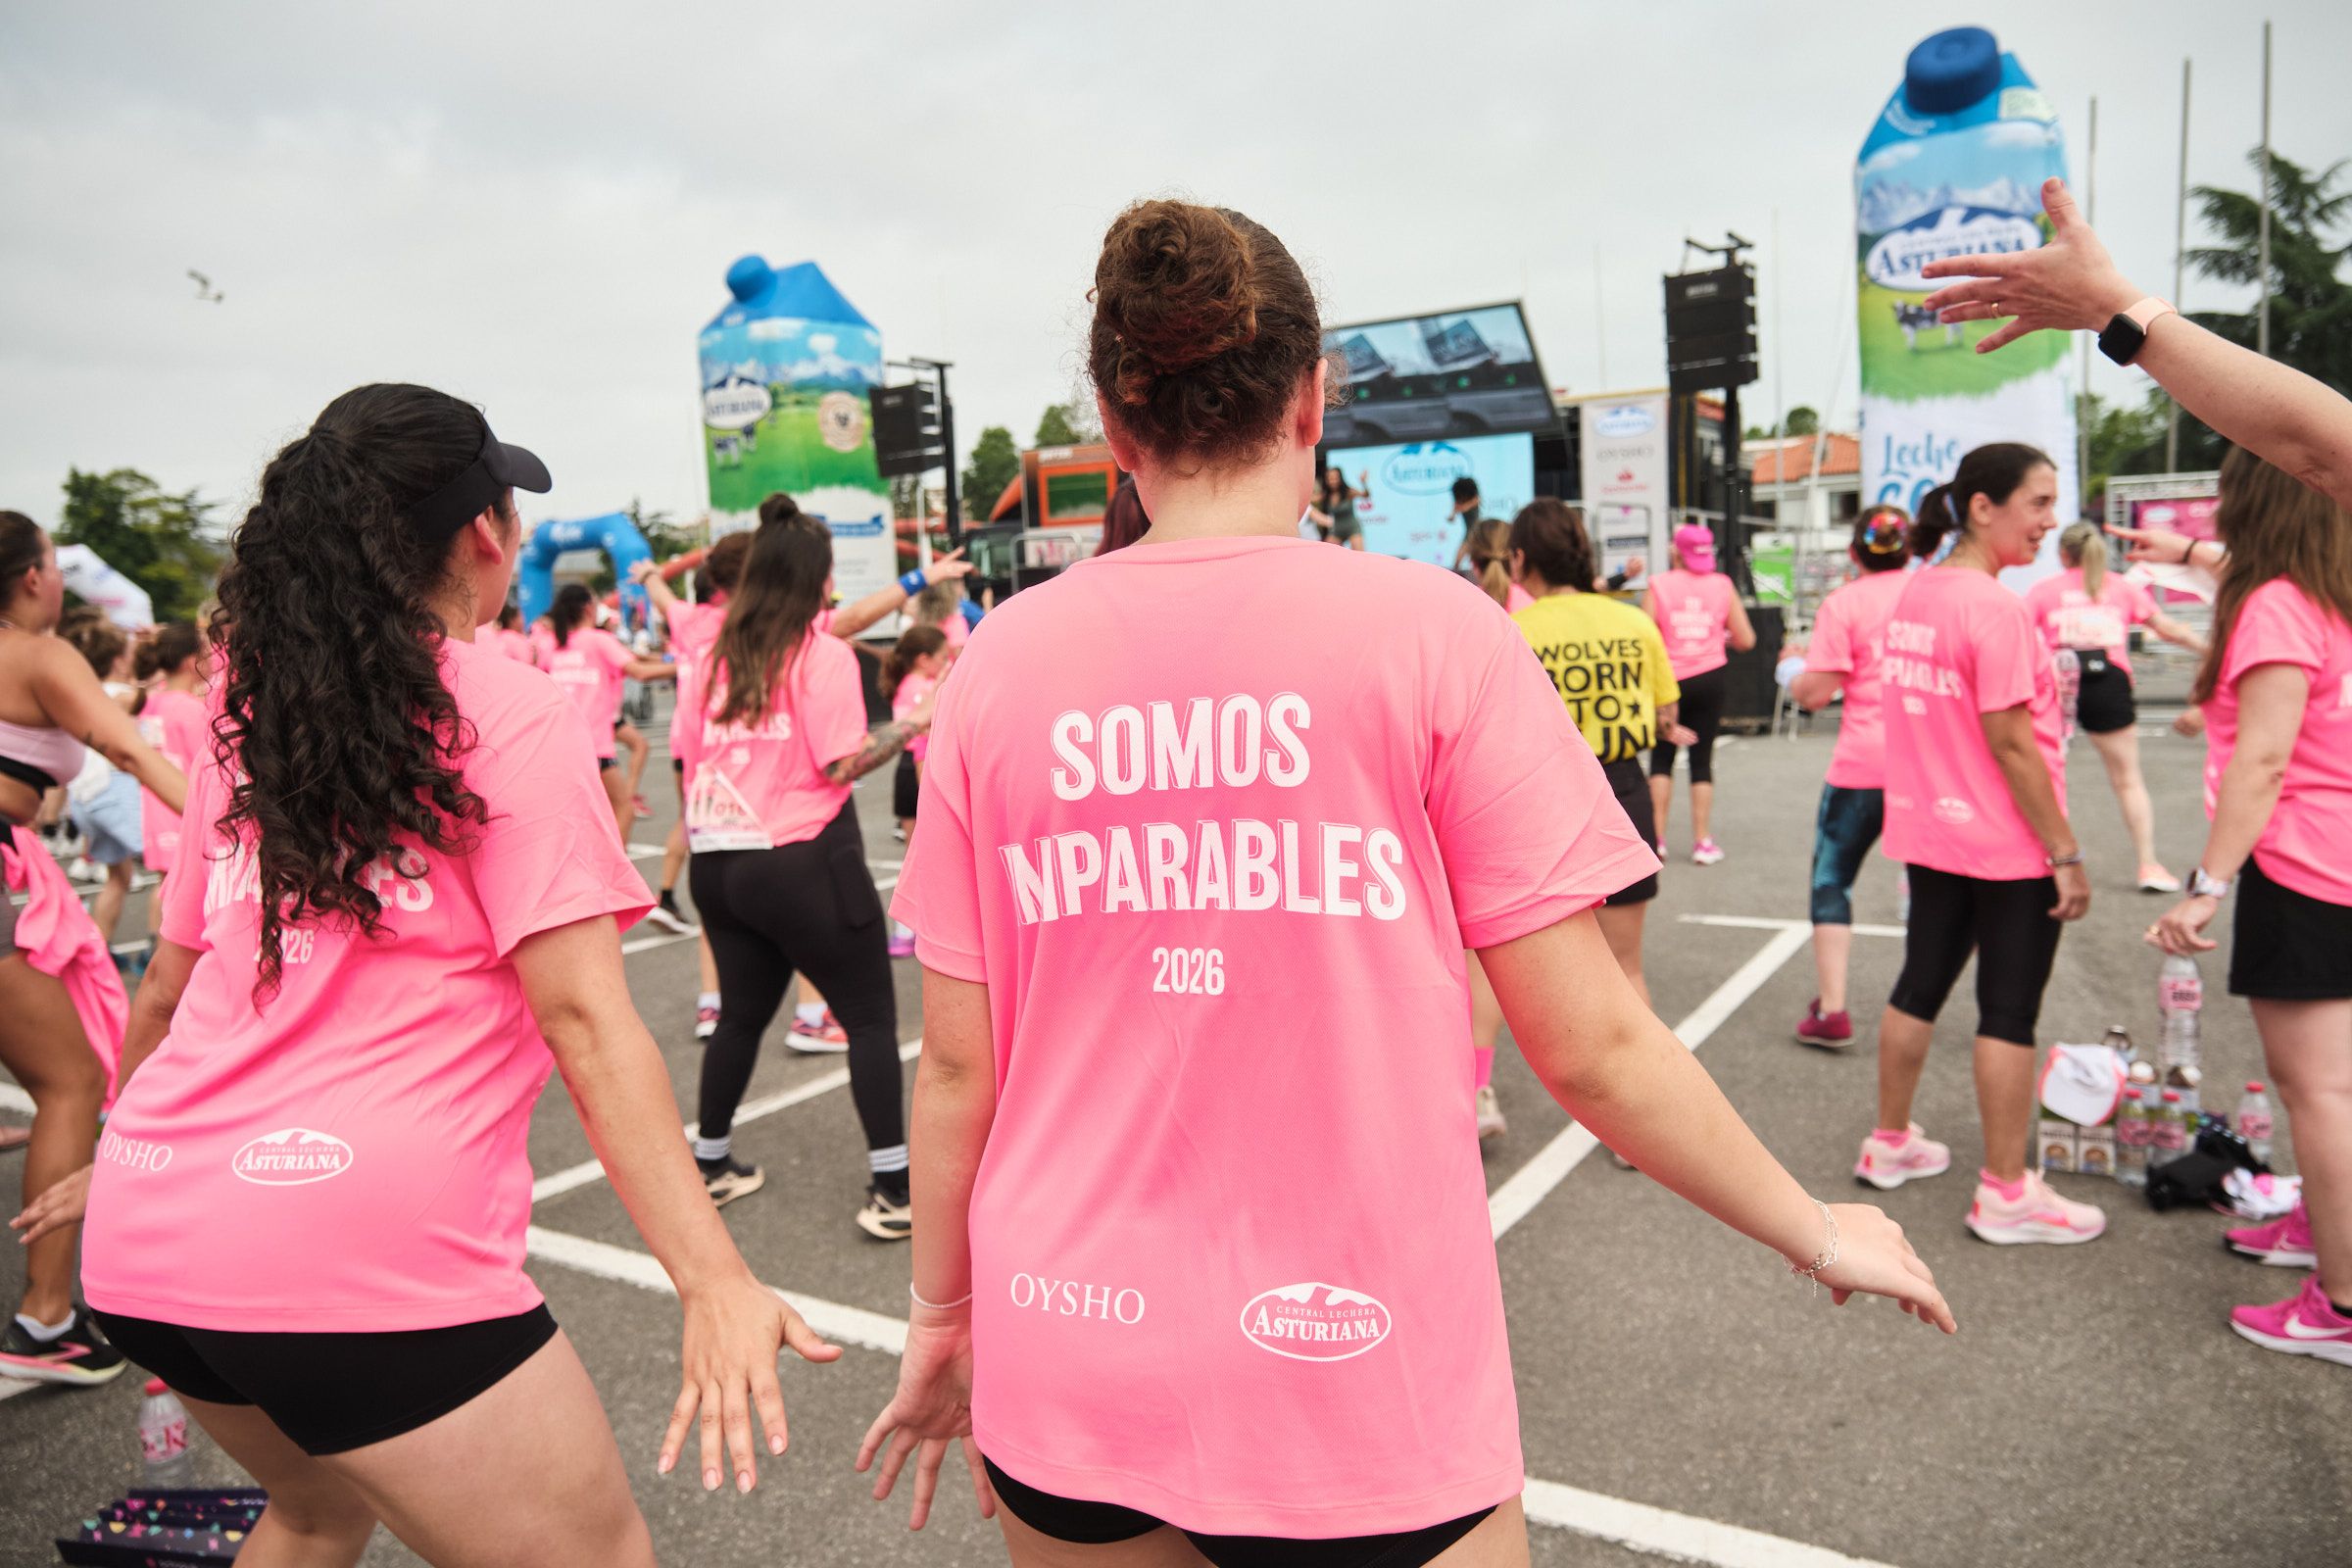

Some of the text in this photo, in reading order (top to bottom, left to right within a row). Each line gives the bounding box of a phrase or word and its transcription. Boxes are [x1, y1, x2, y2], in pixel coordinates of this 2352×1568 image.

[1881, 432, 1957, 479] Leche
[1533, 639, 1643, 662] WOLVES
[1567, 695, 1621, 724] TO
[1051, 691, 1311, 801] SOMOS
[1152, 947, 1225, 996] 2026
[103, 1132, 173, 1172] OYSHO
[238, 1148, 343, 1171] ASTURIANA
[1010, 1273, 1145, 1324] OYSHO
[1276, 1305, 1376, 1319] CENTRAL LECHERA
[1250, 1304, 1381, 1342] ASTURIANA
